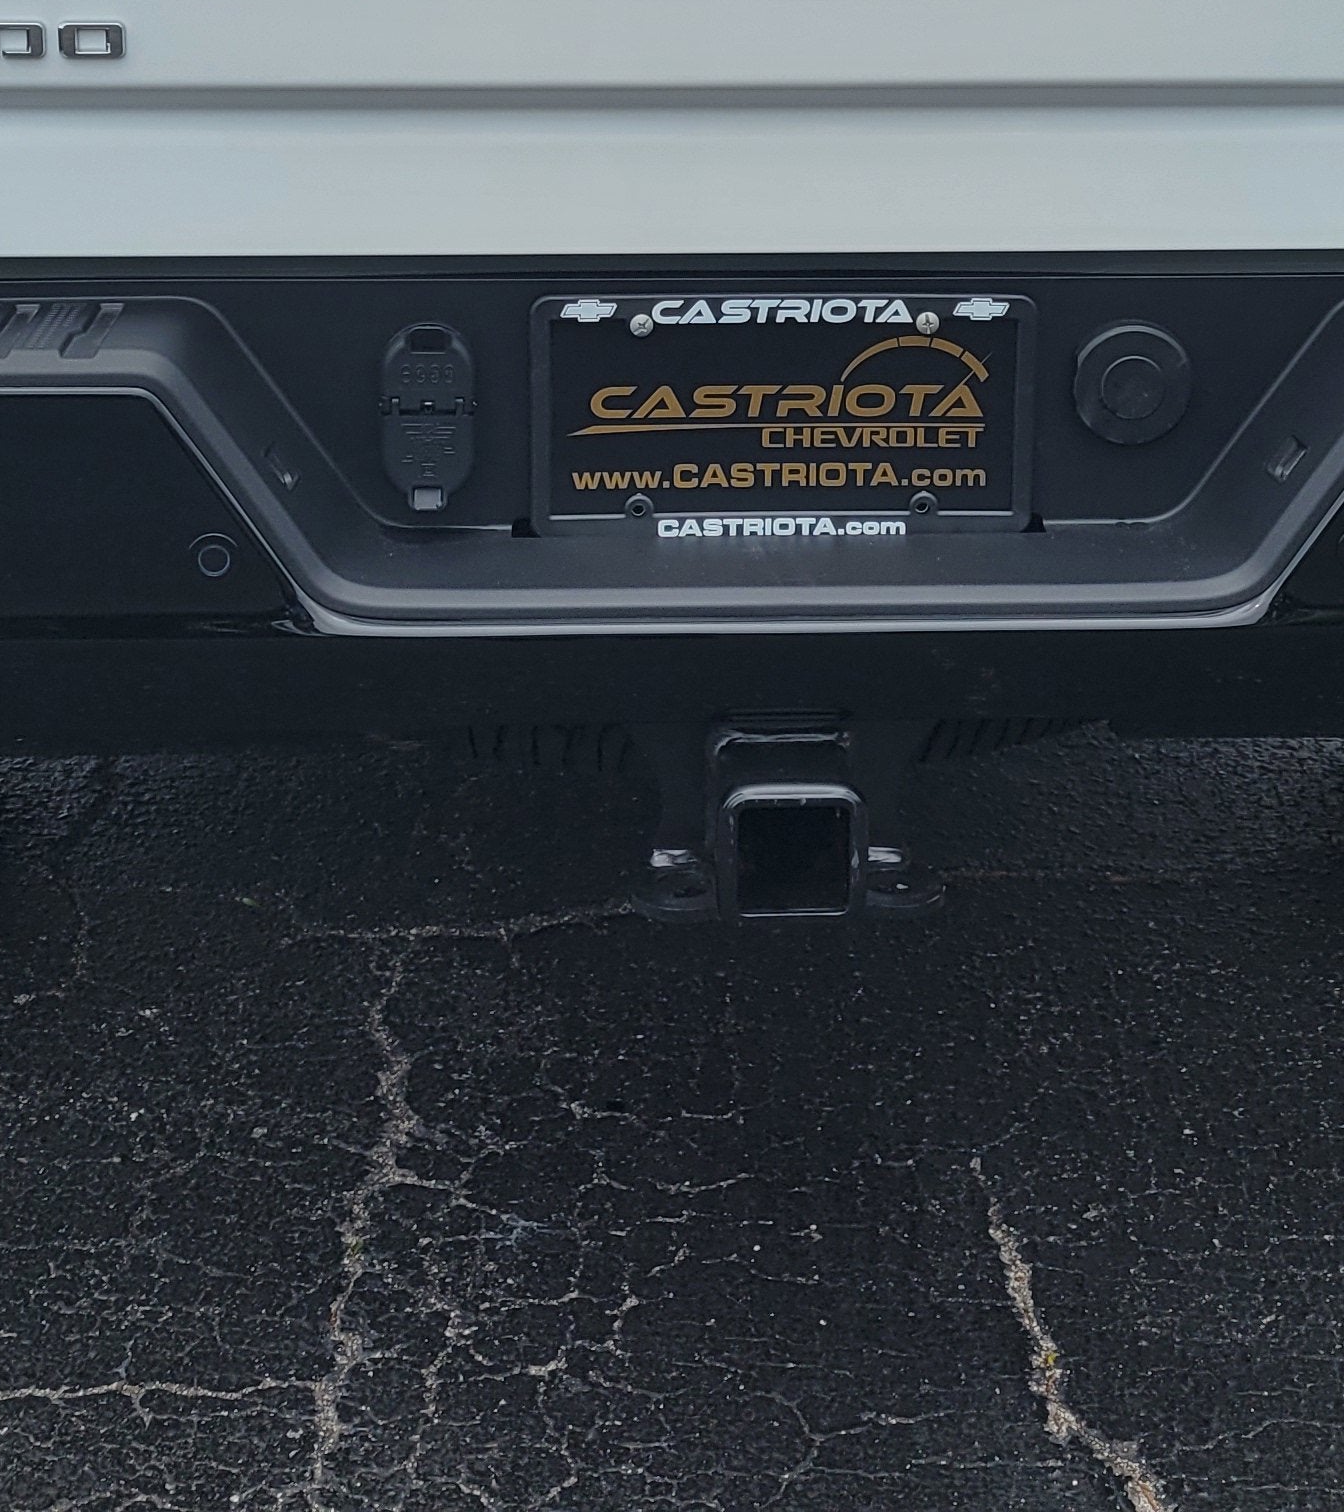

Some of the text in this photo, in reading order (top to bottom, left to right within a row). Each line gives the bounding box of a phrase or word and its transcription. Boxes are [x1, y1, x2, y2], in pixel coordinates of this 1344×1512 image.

[651, 297, 914, 324] CASTRIOTA
[590, 384, 985, 418] CASTRIOTA
[761, 426, 981, 448] CHEVROLET
[571, 461, 987, 490] www.CASTRIOTA.com
[657, 516, 907, 538] CASTRIOTA.com
